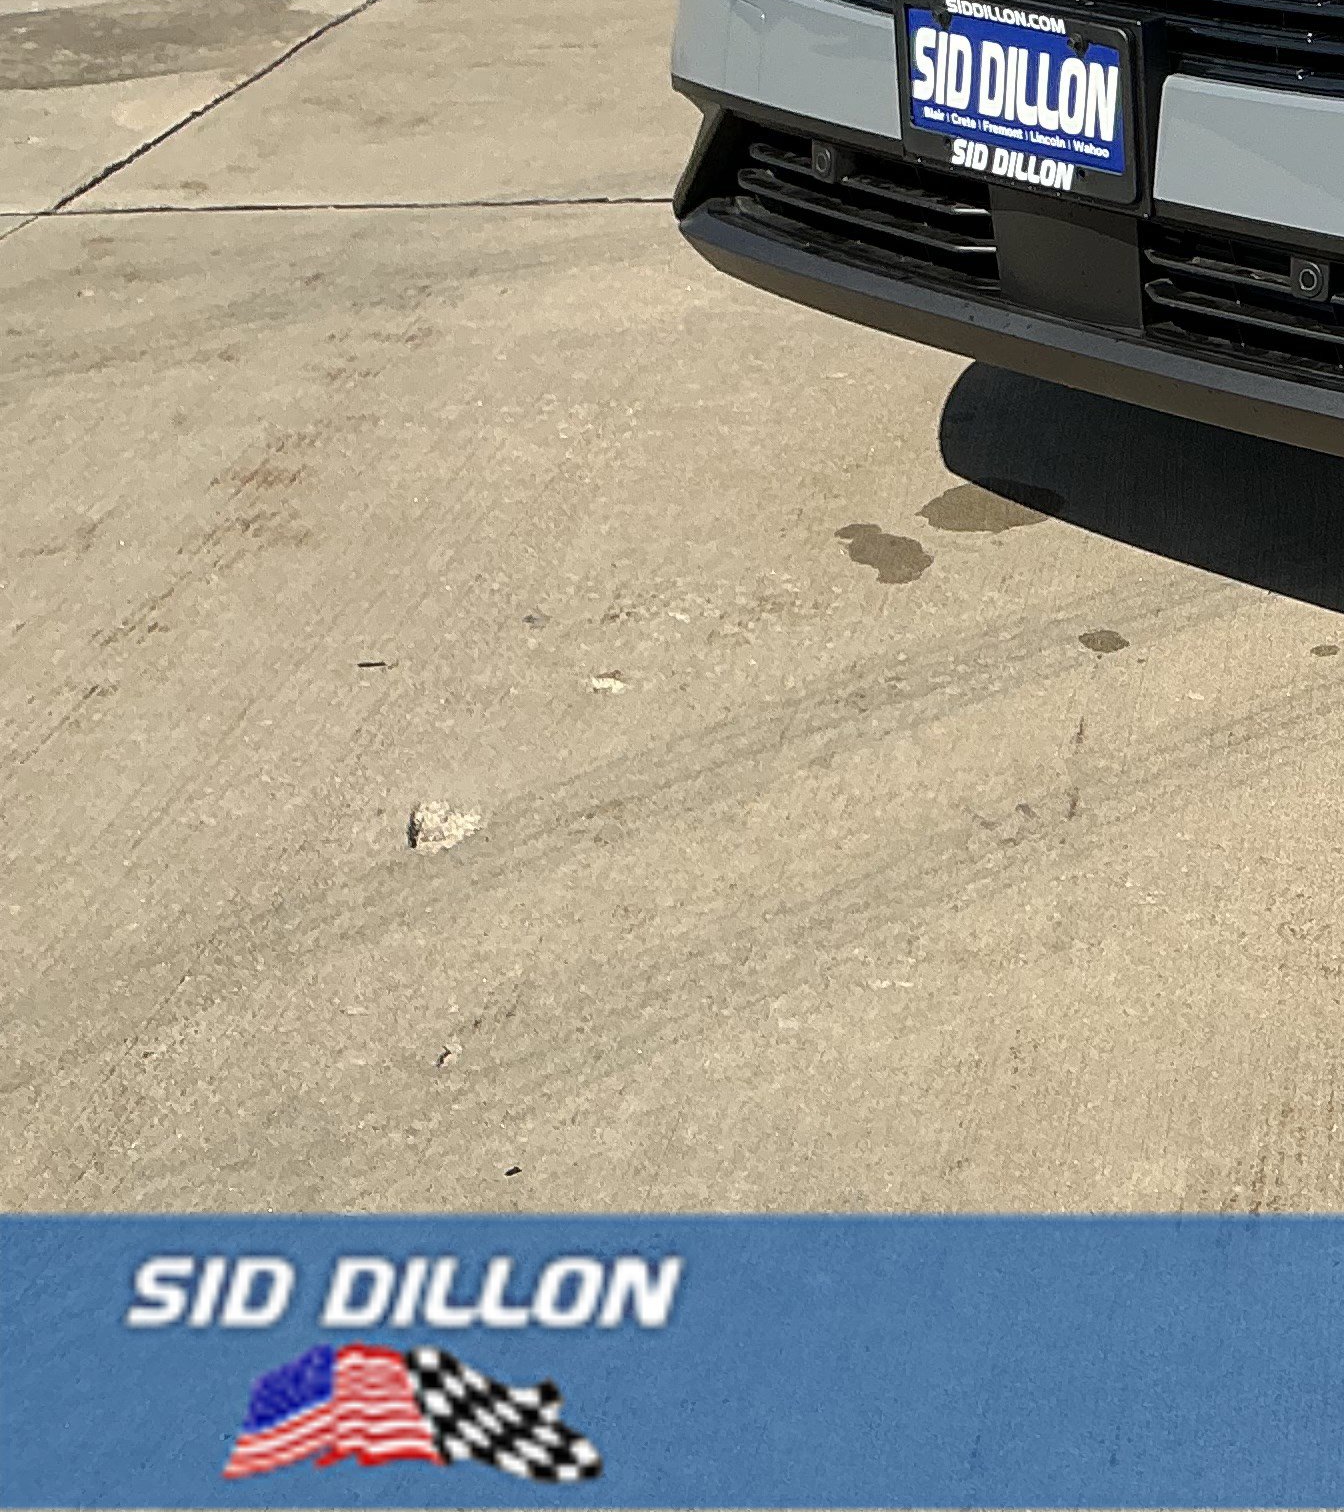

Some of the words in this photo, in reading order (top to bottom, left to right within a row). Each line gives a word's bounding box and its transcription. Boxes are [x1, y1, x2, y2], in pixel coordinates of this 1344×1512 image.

[912, 26, 973, 110] SID
[977, 40, 1119, 142] DILLON
[923, 106, 946, 121] Blair
[951, 113, 977, 130] Crete
[983, 121, 1024, 140] Fremont
[1030, 130, 1067, 149] Lincoln
[950, 138, 989, 171] SID
[991, 146, 1075, 191] DILLON
